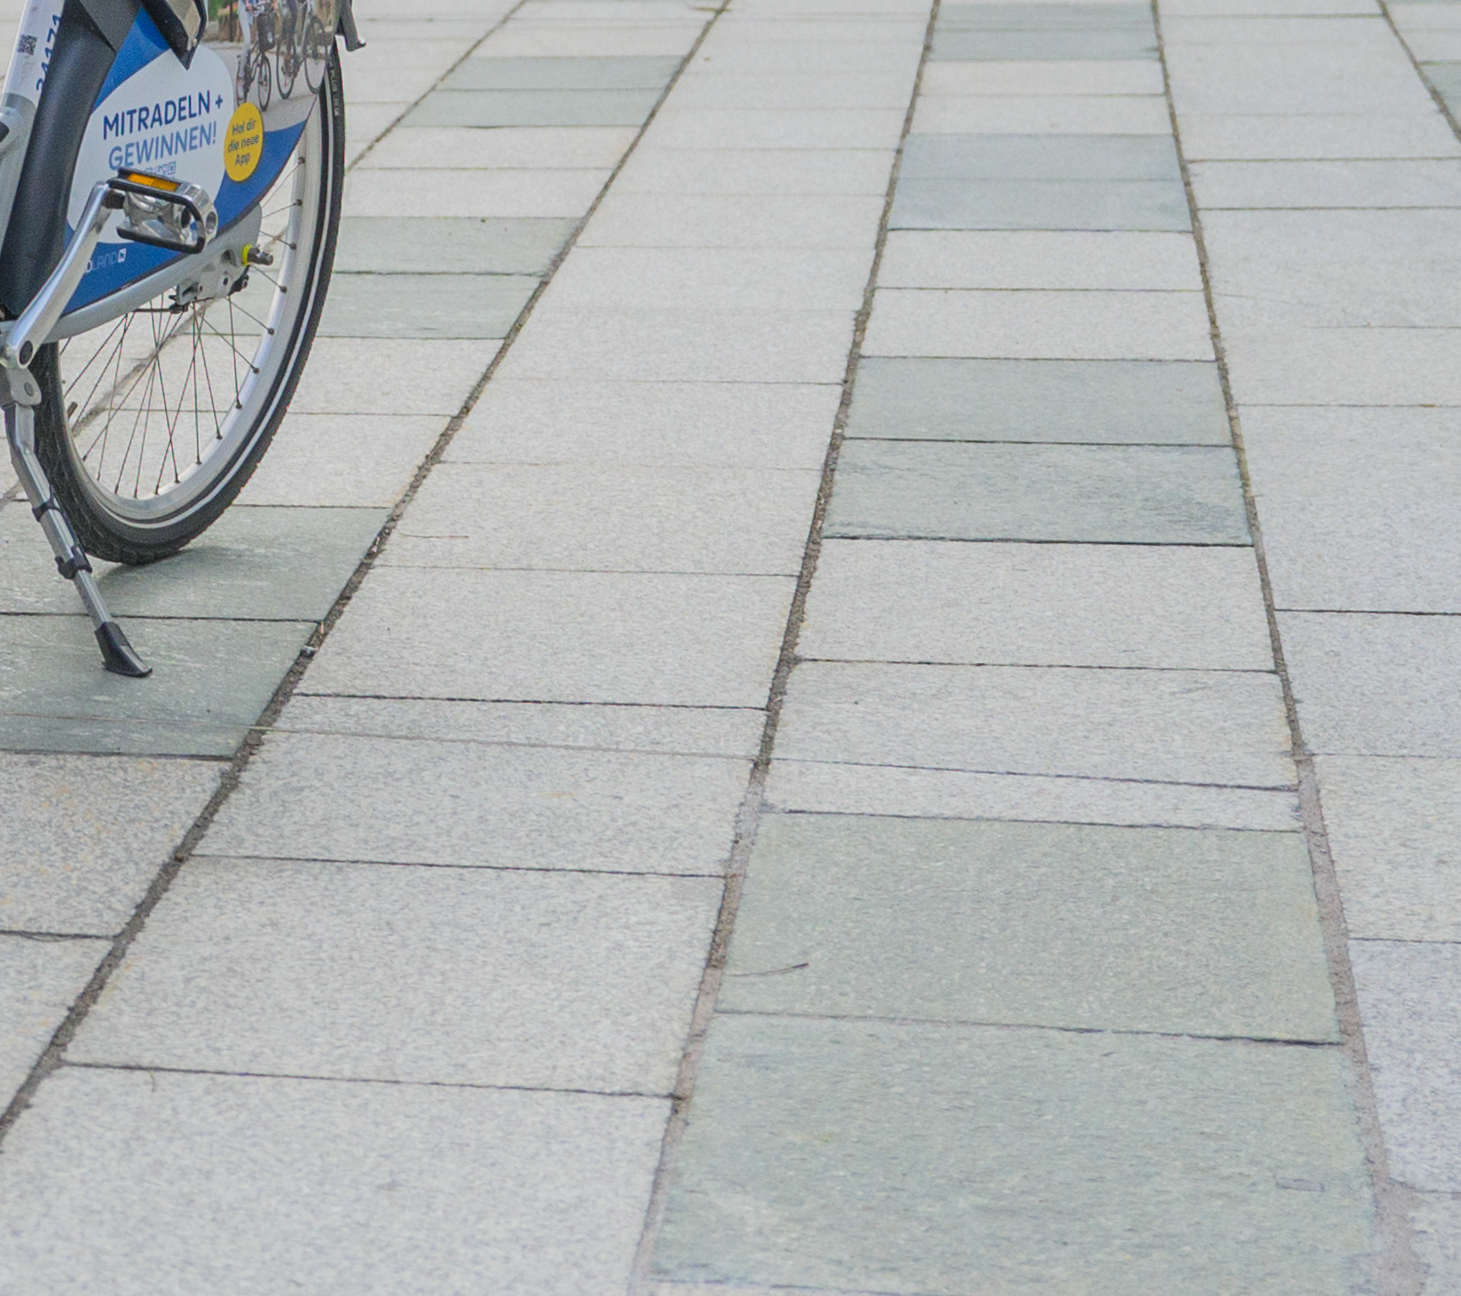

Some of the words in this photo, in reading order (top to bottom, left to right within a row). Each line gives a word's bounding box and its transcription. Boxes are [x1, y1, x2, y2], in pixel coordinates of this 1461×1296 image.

[102, 89, 210, 140] MITRADELN
[215, 94, 223, 109] +
[232, 120, 245, 136] Hol
[246, 117, 257, 131] dir
[108, 121, 217, 171] GEWINNEN!
[228, 139, 239, 153] die
[234, 152, 251, 166] App
